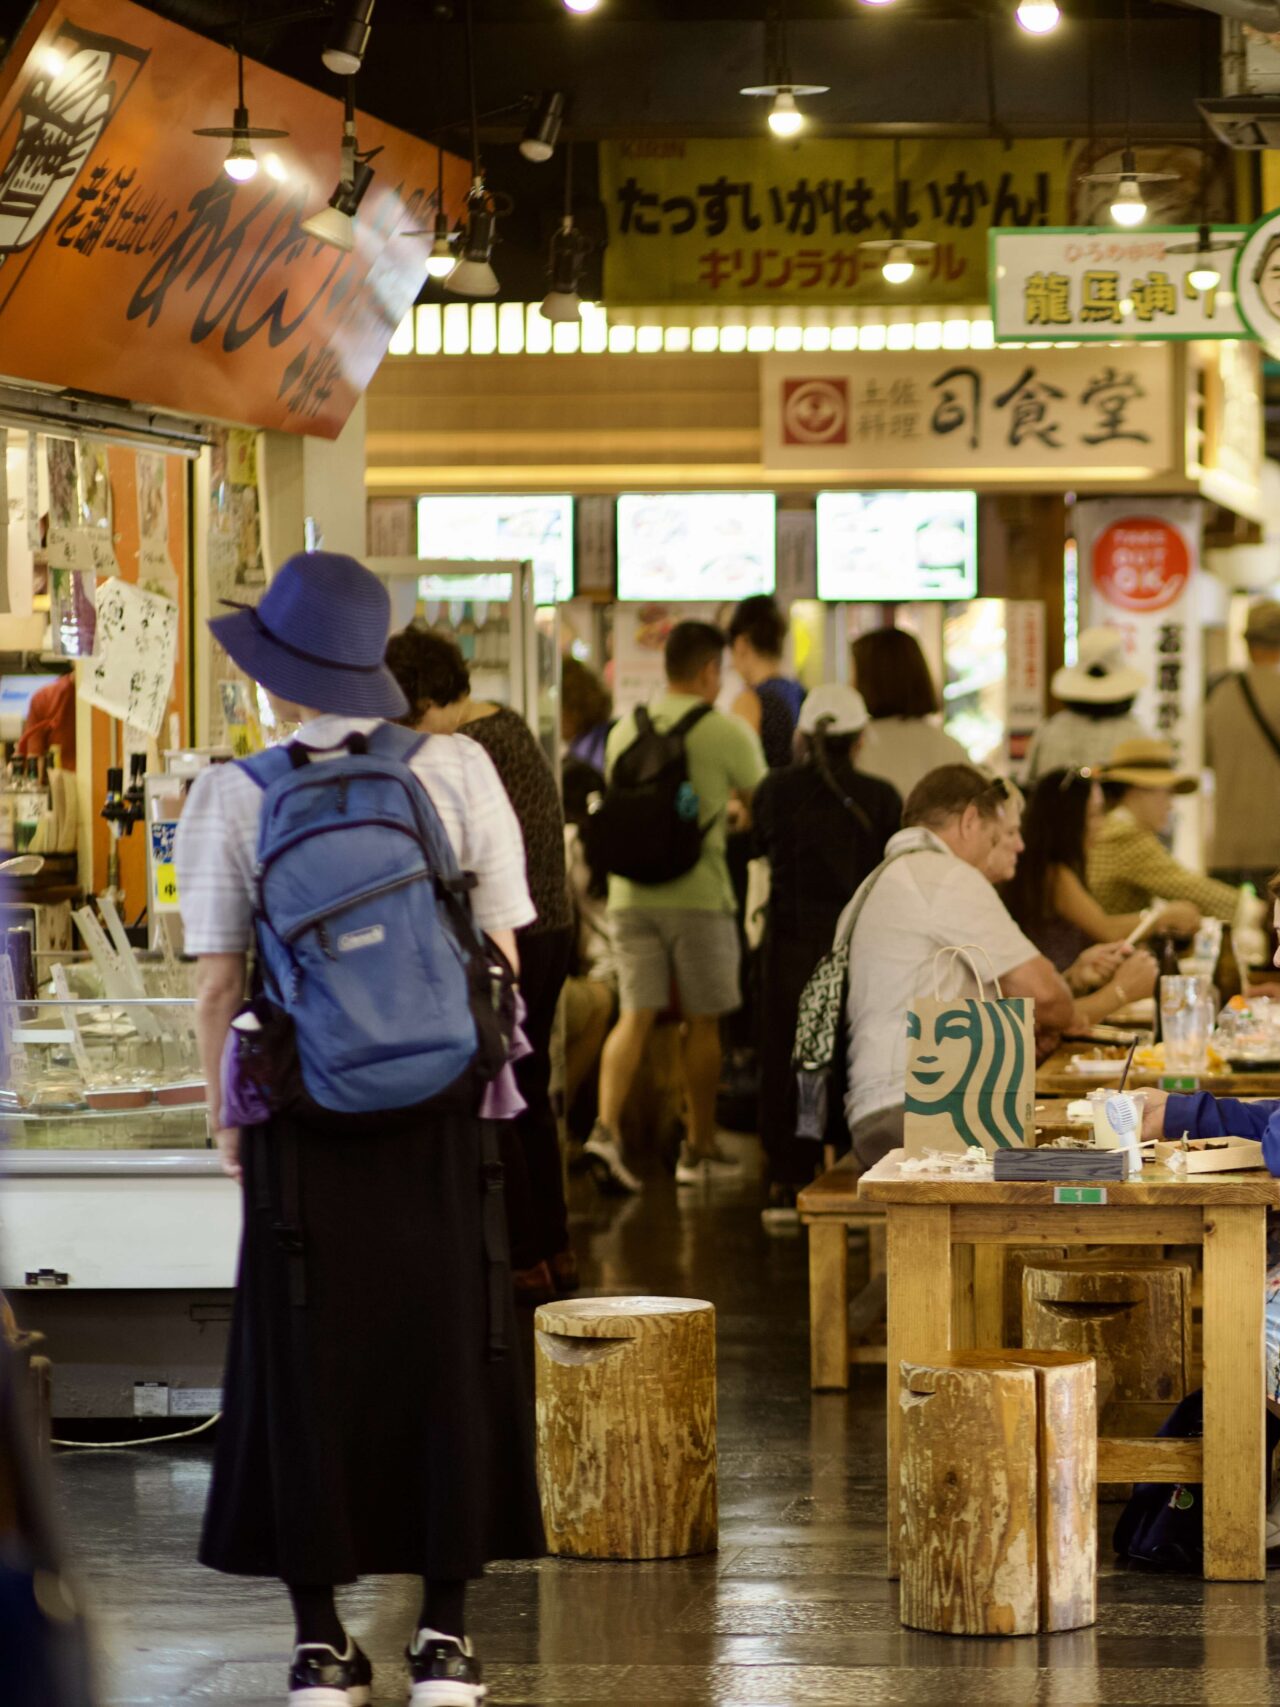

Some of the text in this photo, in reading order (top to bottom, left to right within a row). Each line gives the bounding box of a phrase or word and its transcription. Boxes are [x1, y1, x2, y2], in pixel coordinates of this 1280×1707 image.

[700, 248, 966, 289] キリンラガーール
[1075, 1190, 1083, 1202] 1
